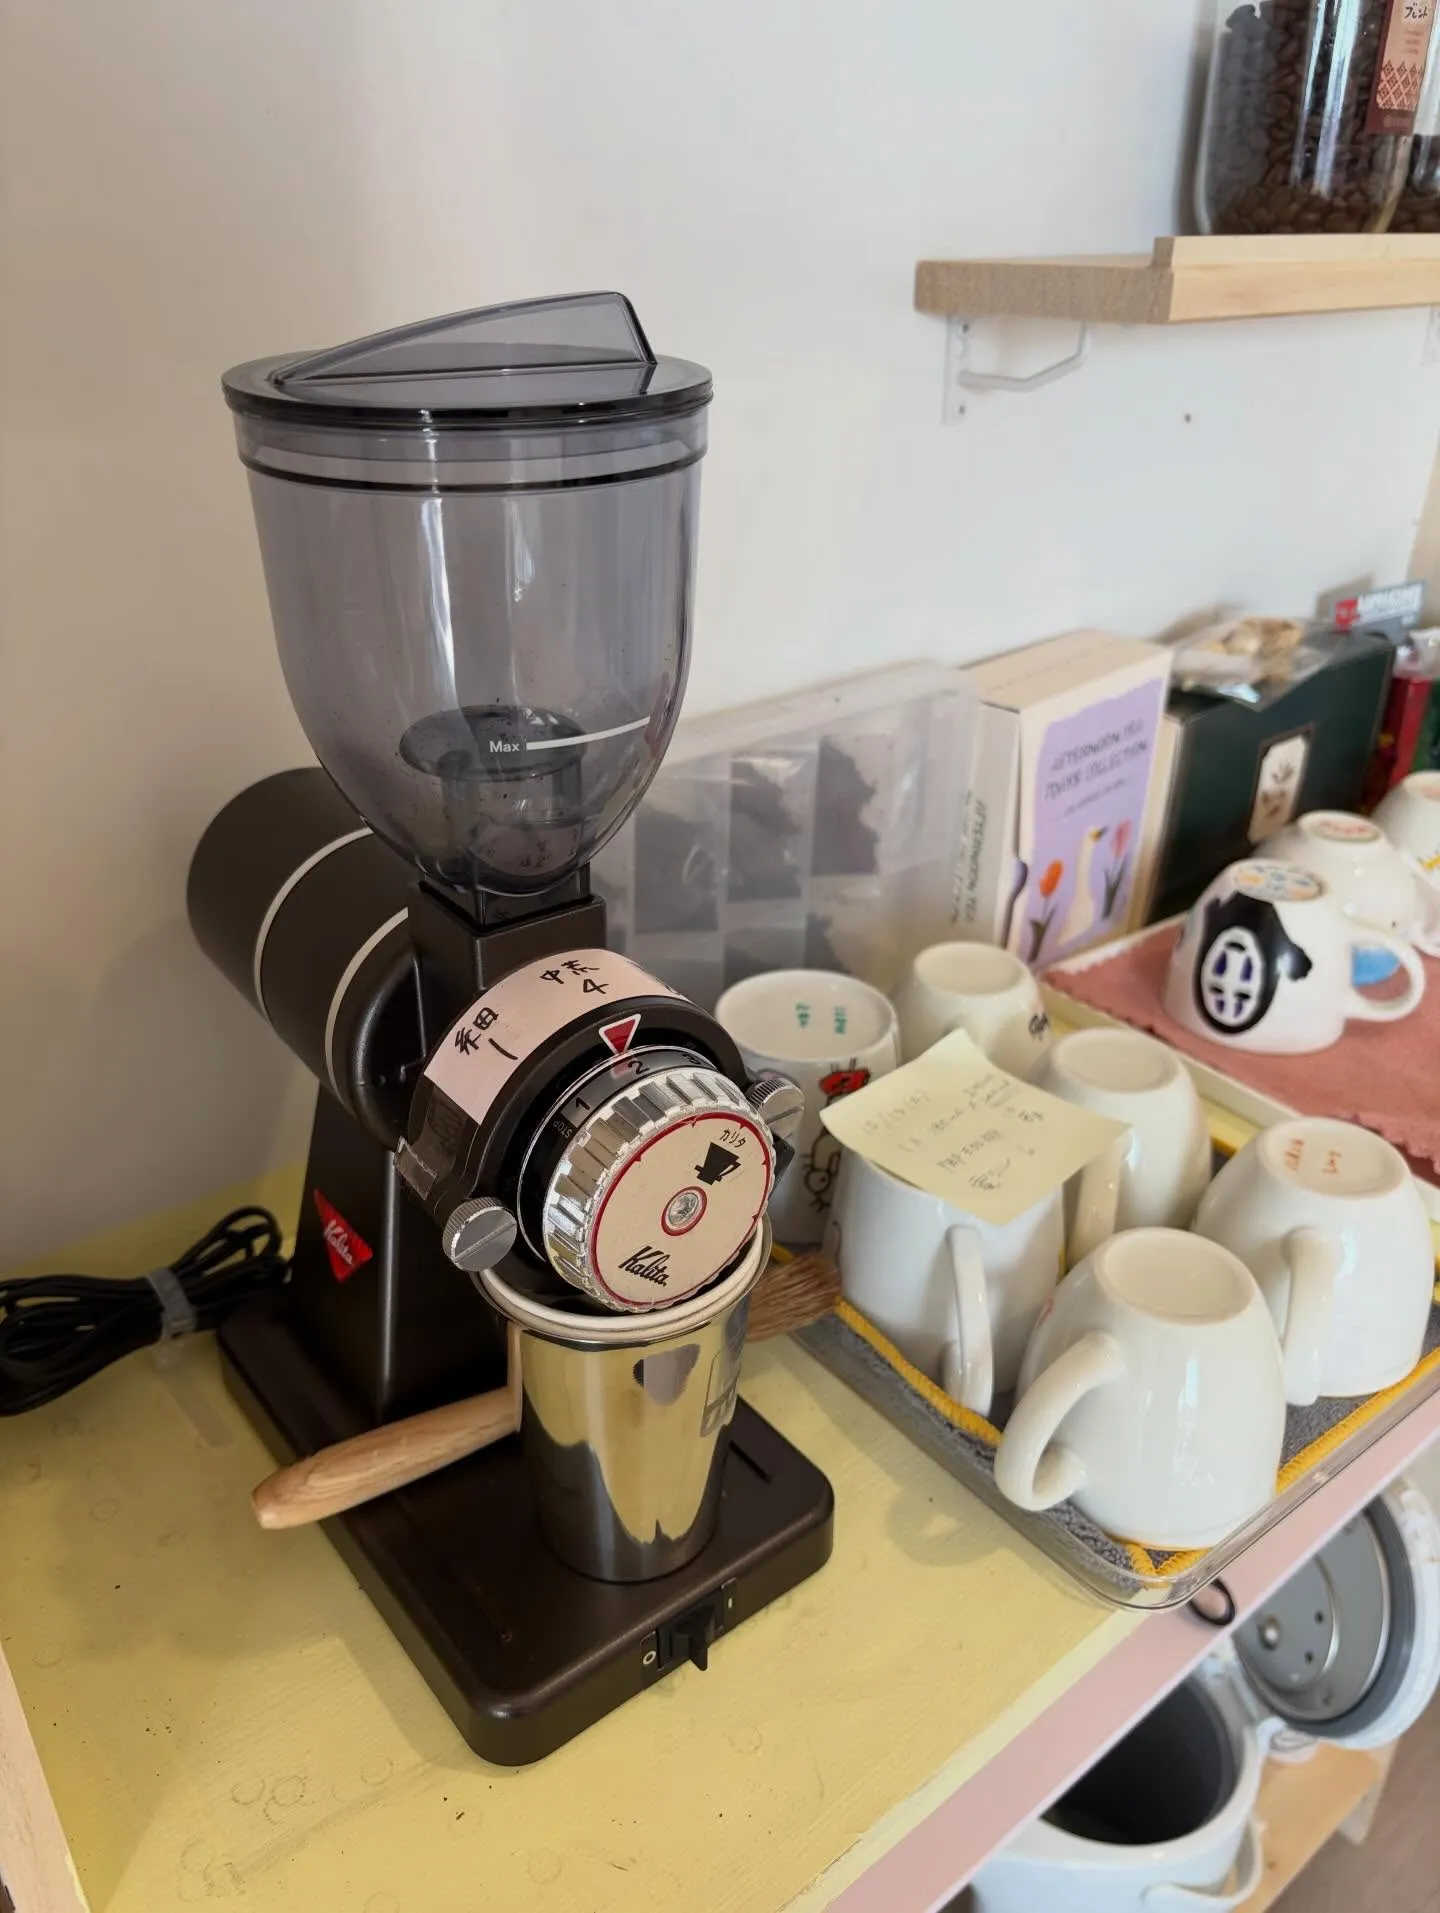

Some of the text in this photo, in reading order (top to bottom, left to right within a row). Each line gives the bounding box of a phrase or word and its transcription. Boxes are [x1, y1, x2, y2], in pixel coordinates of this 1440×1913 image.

[489, 740, 520, 753] Max
[583, 978, 609, 995] 4
[628, 1060, 650, 1075] 2
[575, 1096, 591, 1111] 1
[552, 1120, 574, 1139] STOP
[719, 1128, 747, 1149] カリタ
